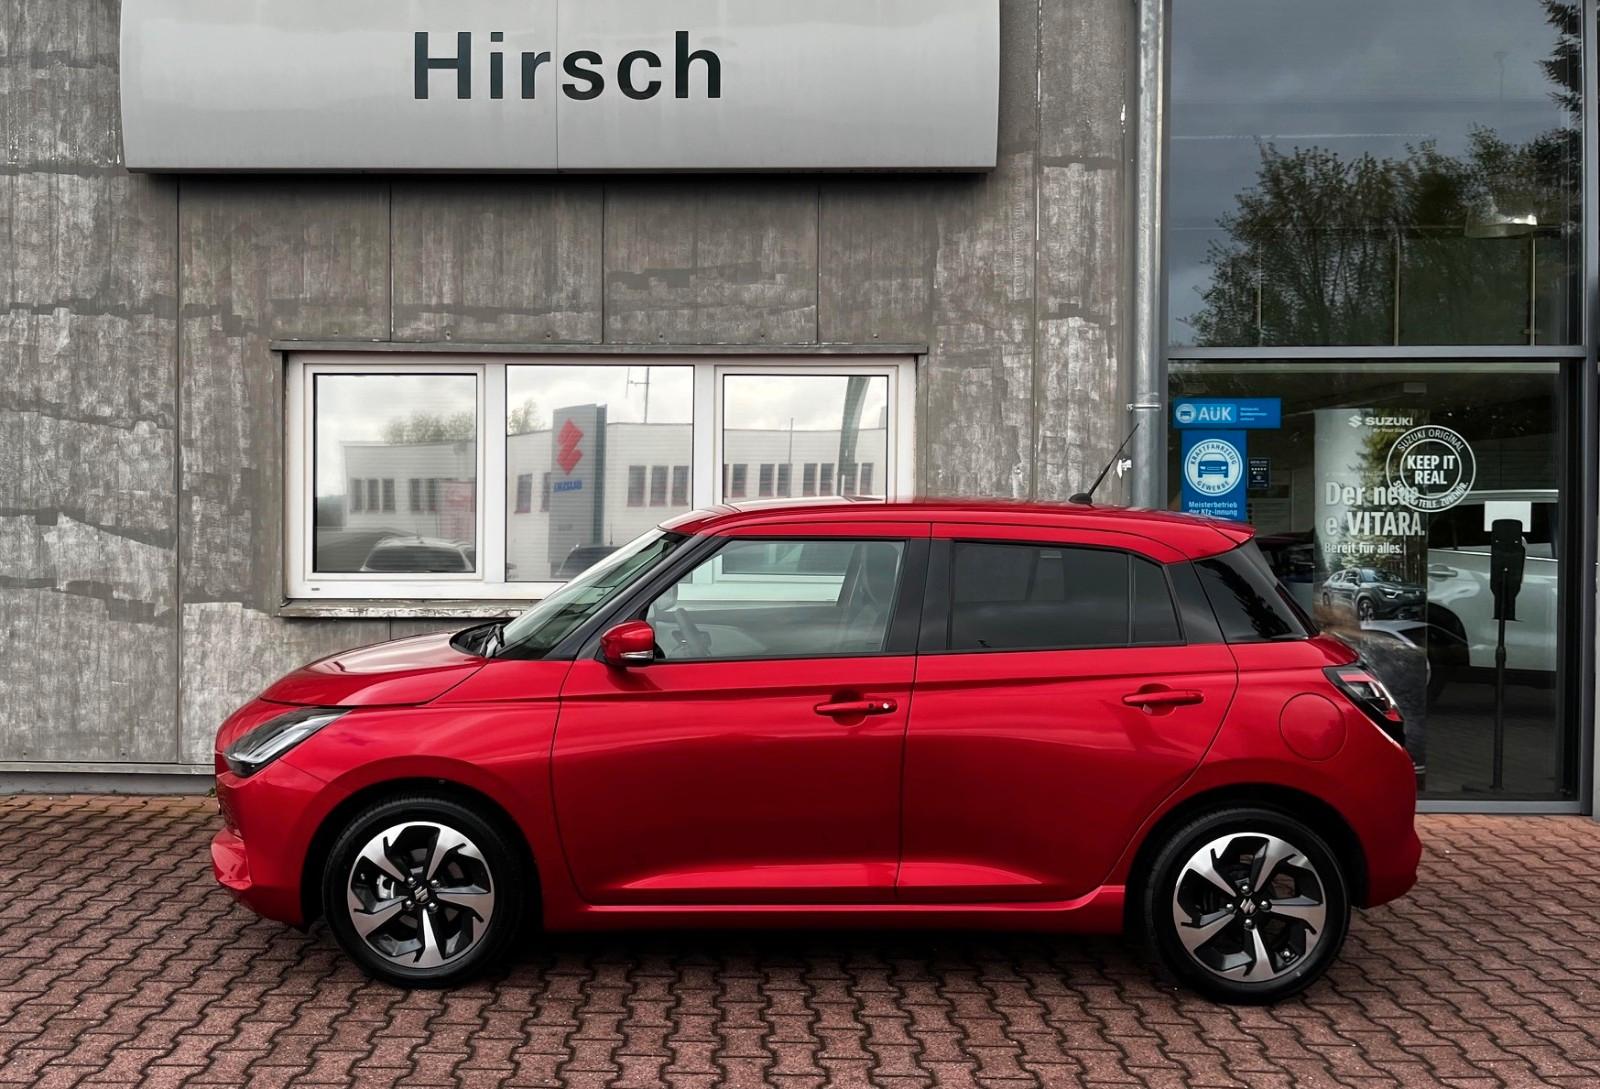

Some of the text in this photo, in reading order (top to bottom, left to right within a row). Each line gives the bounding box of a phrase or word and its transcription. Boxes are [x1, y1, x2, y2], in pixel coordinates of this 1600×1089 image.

[414, 30, 721, 101] Hirsch
[1365, 416, 1414, 426] SUZUKI
[1397, 428, 1465, 453] SUZUKI ORIGINAL
[1190, 442, 1238, 465] KRAFTFAHRZEUG
[1407, 455, 1455, 470] KEEP IT
[1414, 470, 1448, 484] REAL
[1196, 480, 1230, 492] GEWERBE
[1325, 481, 1366, 506] Der
[1201, 508, 1238, 517] Kfz-Innung
[1325, 511, 1426, 536] e VITARA.
[1324, 541, 1404, 554] Bereit für alles.
